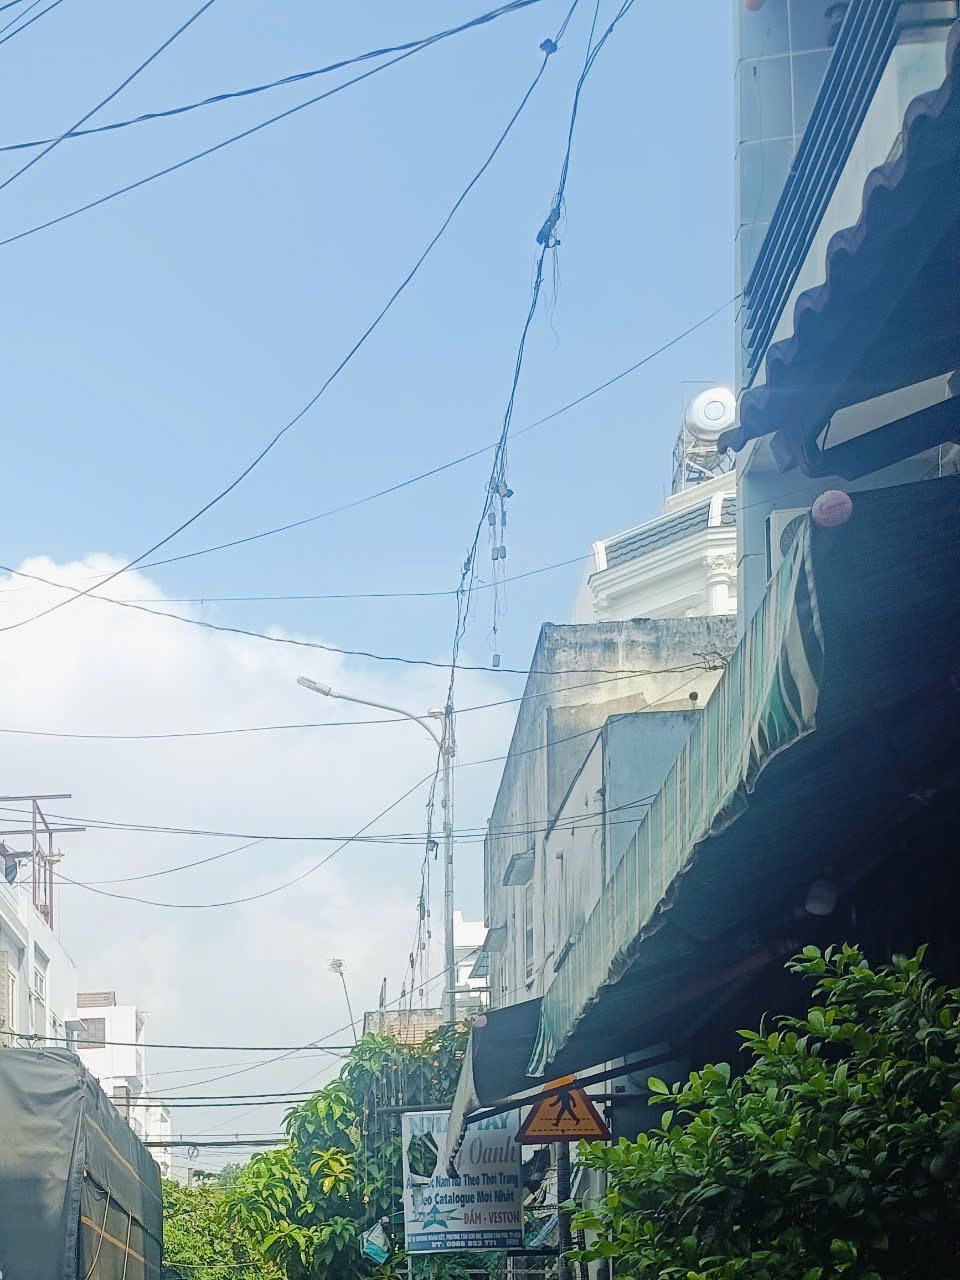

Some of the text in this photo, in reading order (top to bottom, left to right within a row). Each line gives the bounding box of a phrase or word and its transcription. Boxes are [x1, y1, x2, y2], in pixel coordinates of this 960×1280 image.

[470, 1136, 517, 1165] Oanh
[463, 1173, 480, 1186] Theo
[499, 1172, 519, 1188] Trang
[411, 1194, 433, 1206] Teo
[435, 1191, 475, 1208] Catalogue
[488, 1210, 520, 1224] VESTON
